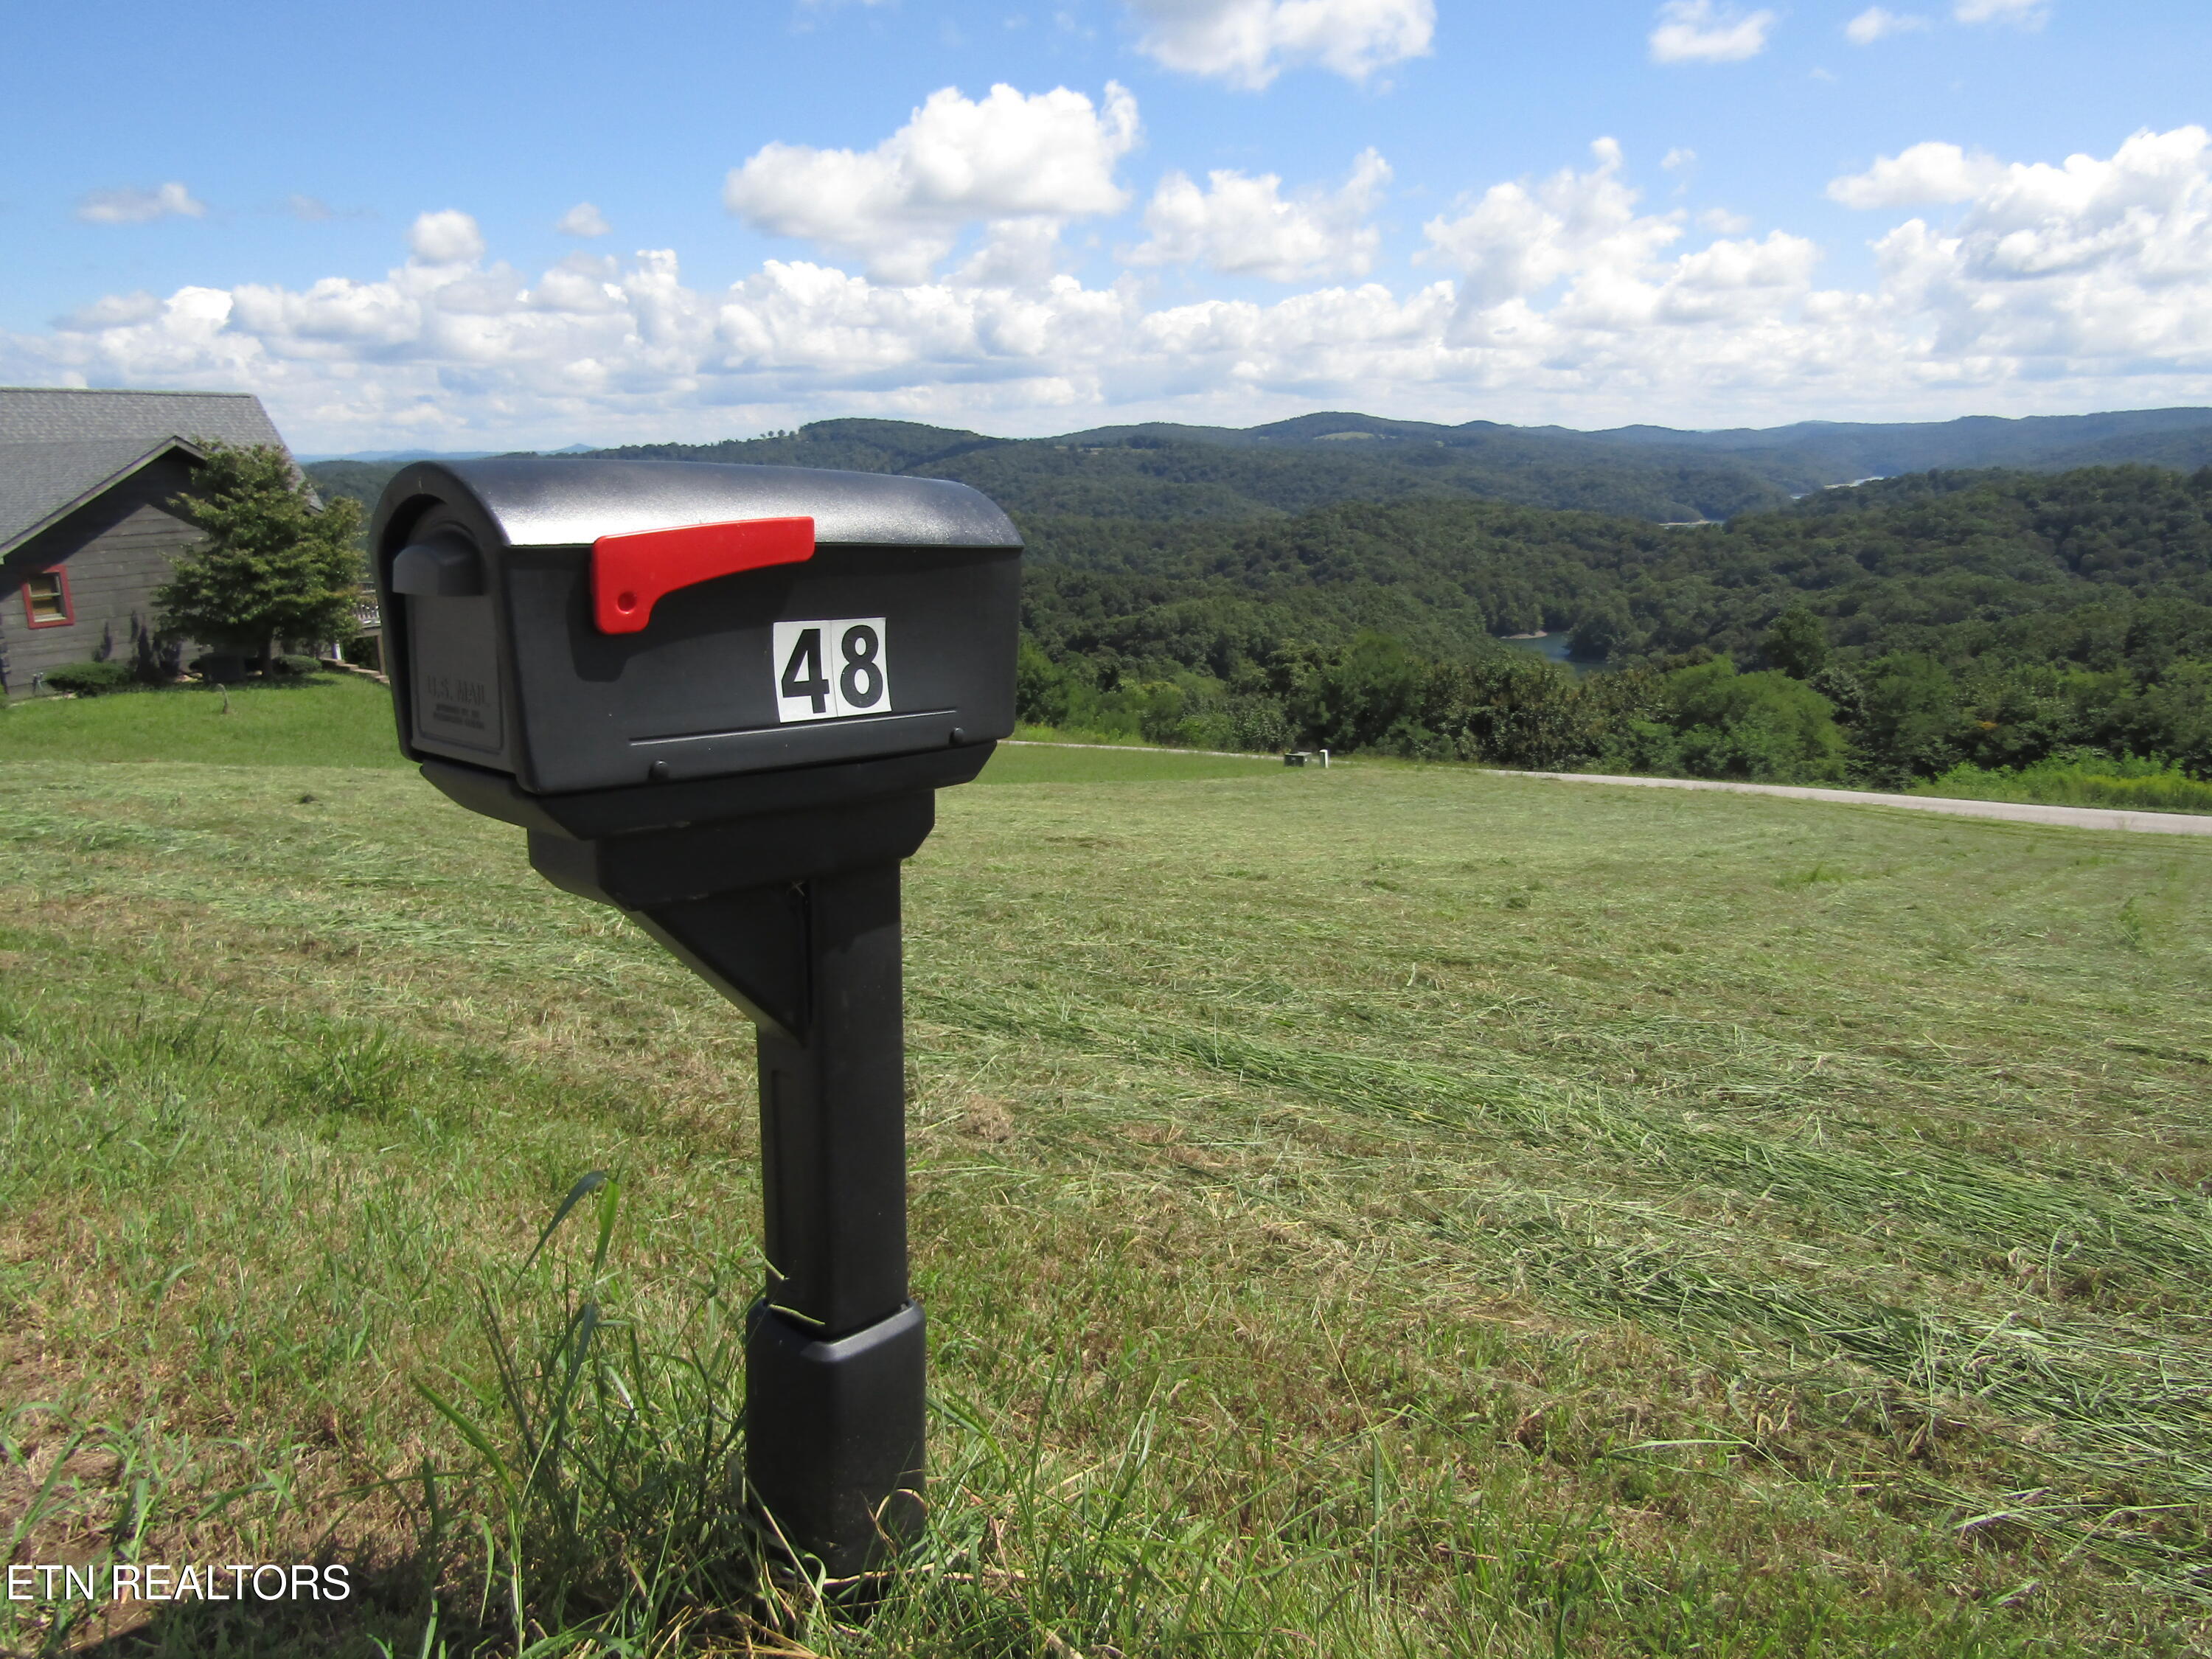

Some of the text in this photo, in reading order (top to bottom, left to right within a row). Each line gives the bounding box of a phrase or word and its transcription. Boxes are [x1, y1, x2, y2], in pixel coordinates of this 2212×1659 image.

[425, 675, 492, 709] U.S. MAIL
[781, 625, 884, 714] 48
